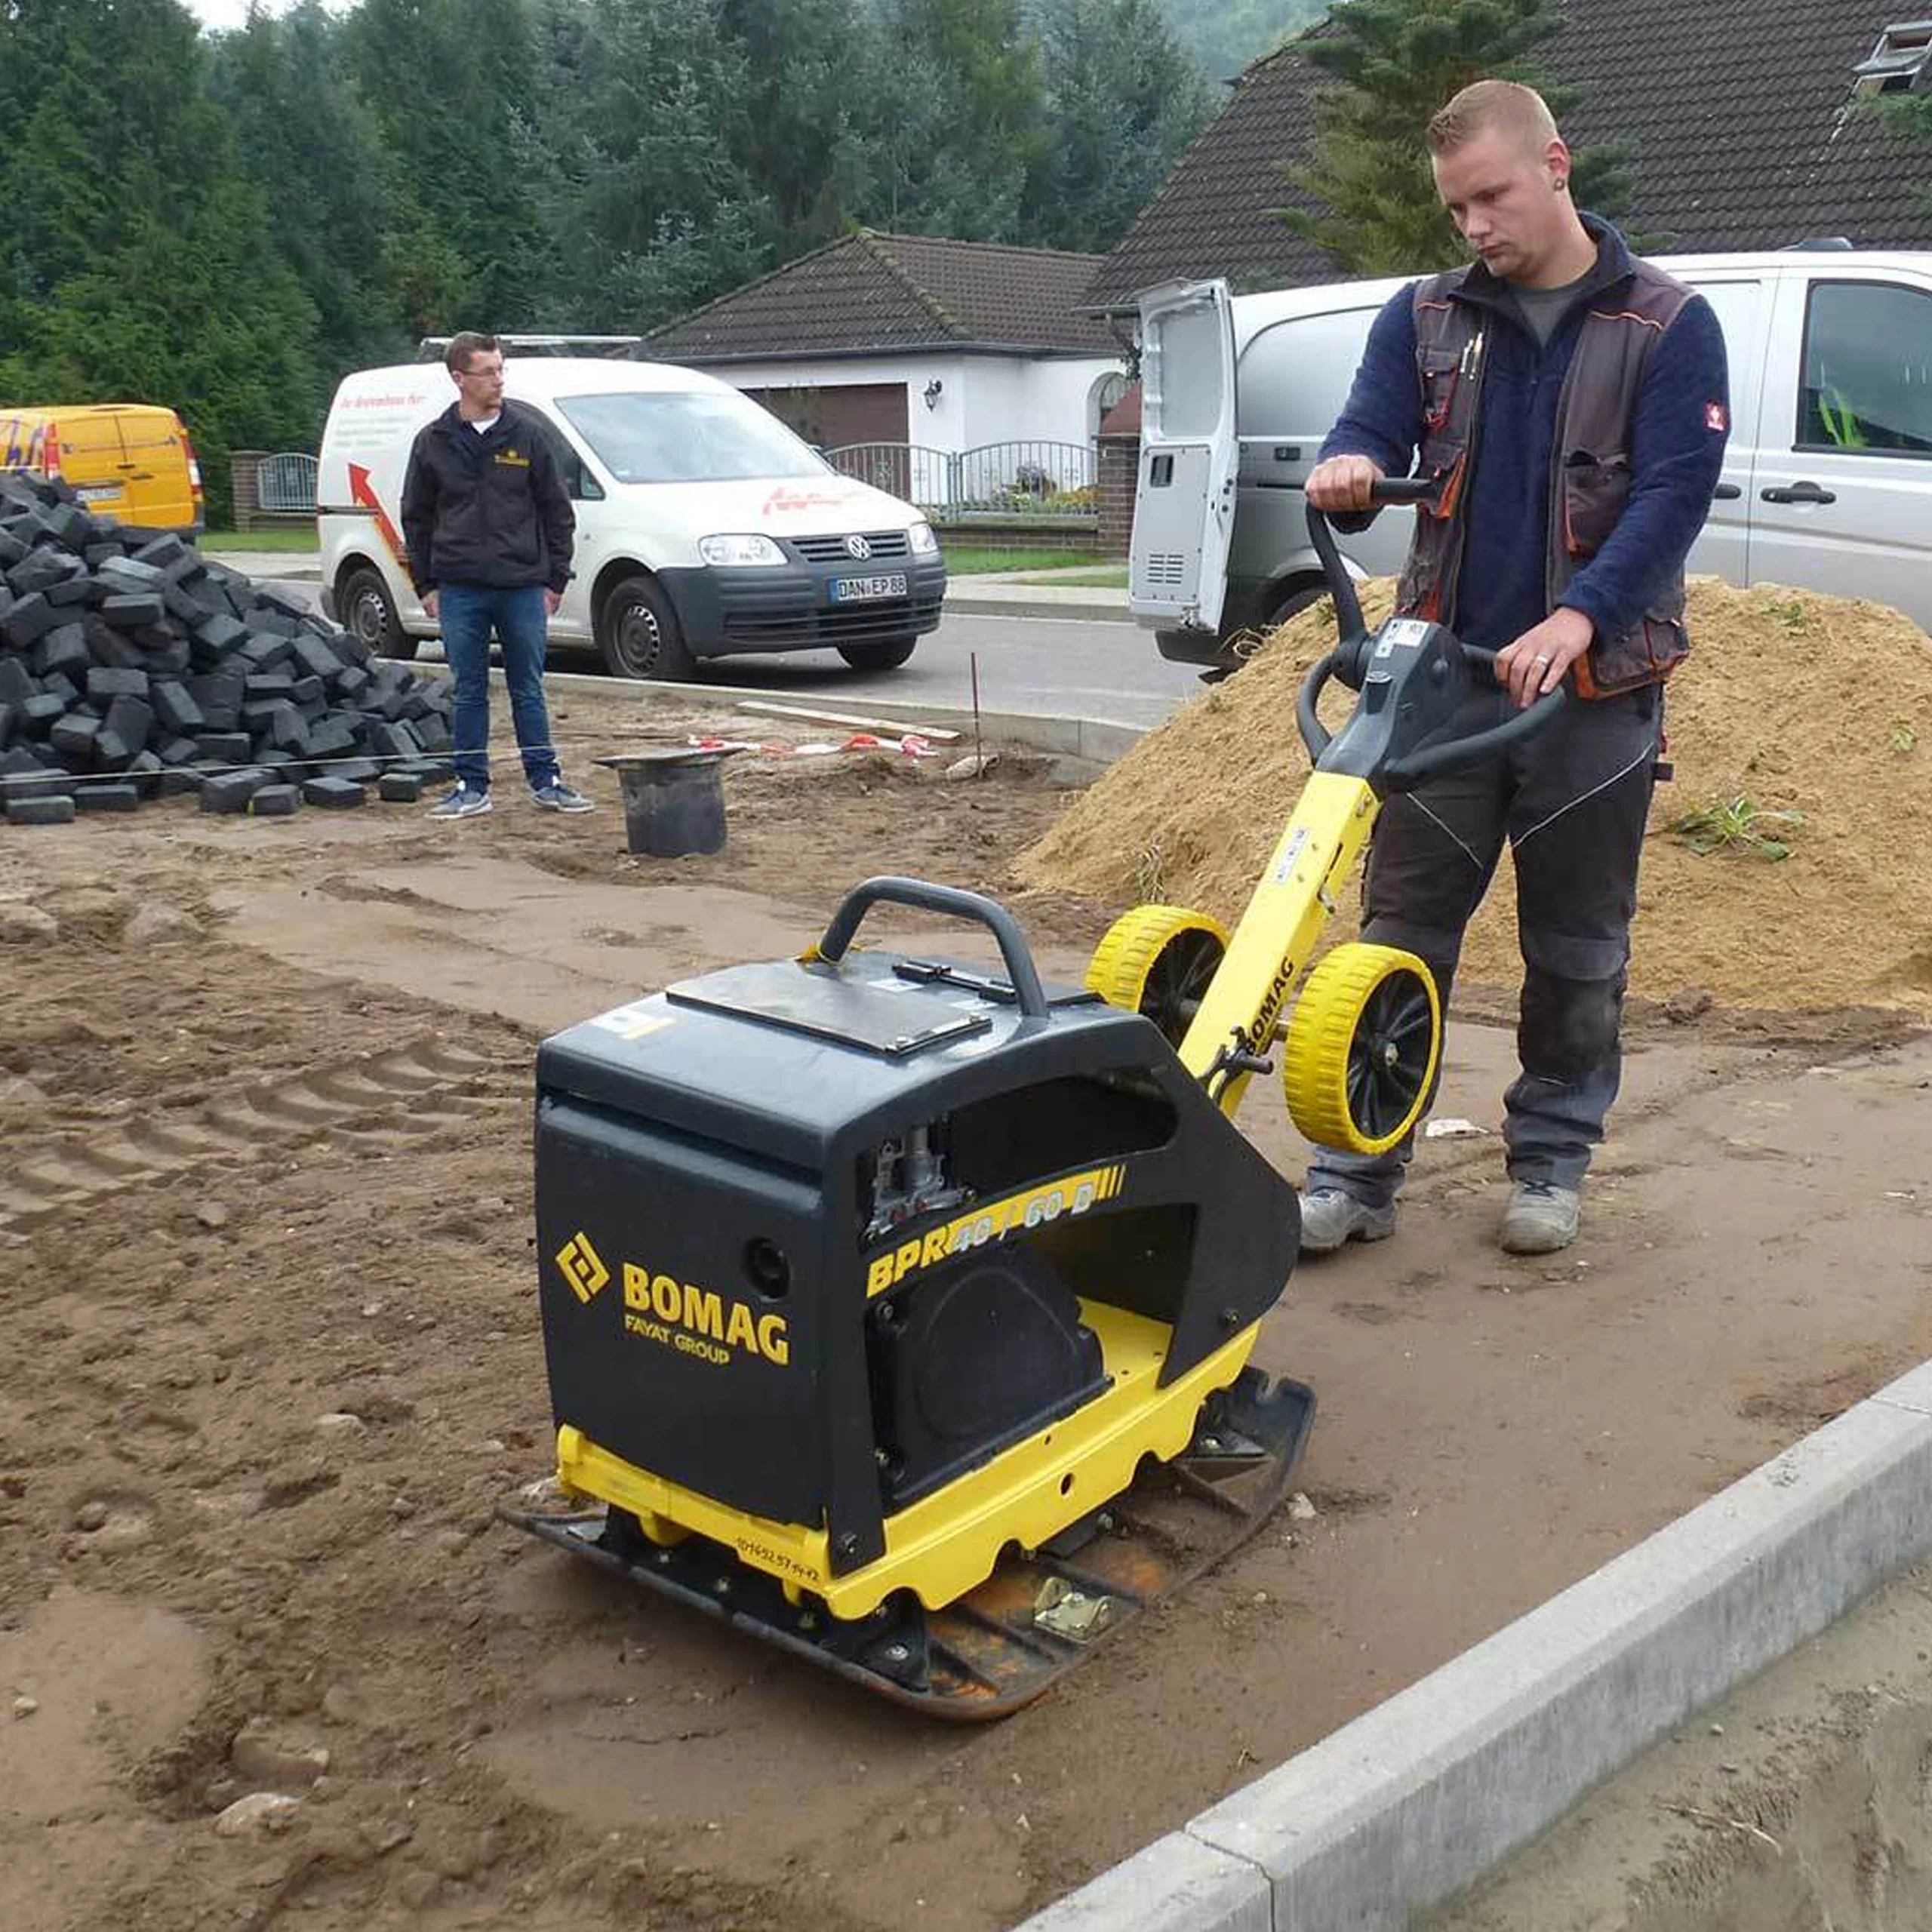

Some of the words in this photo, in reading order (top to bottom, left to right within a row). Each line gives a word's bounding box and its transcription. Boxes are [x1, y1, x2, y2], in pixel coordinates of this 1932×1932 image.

[623, 1262, 789, 1366] BOMAG
[624, 1315, 670, 1343] FAYAT
[674, 1334, 731, 1365] GROUP
